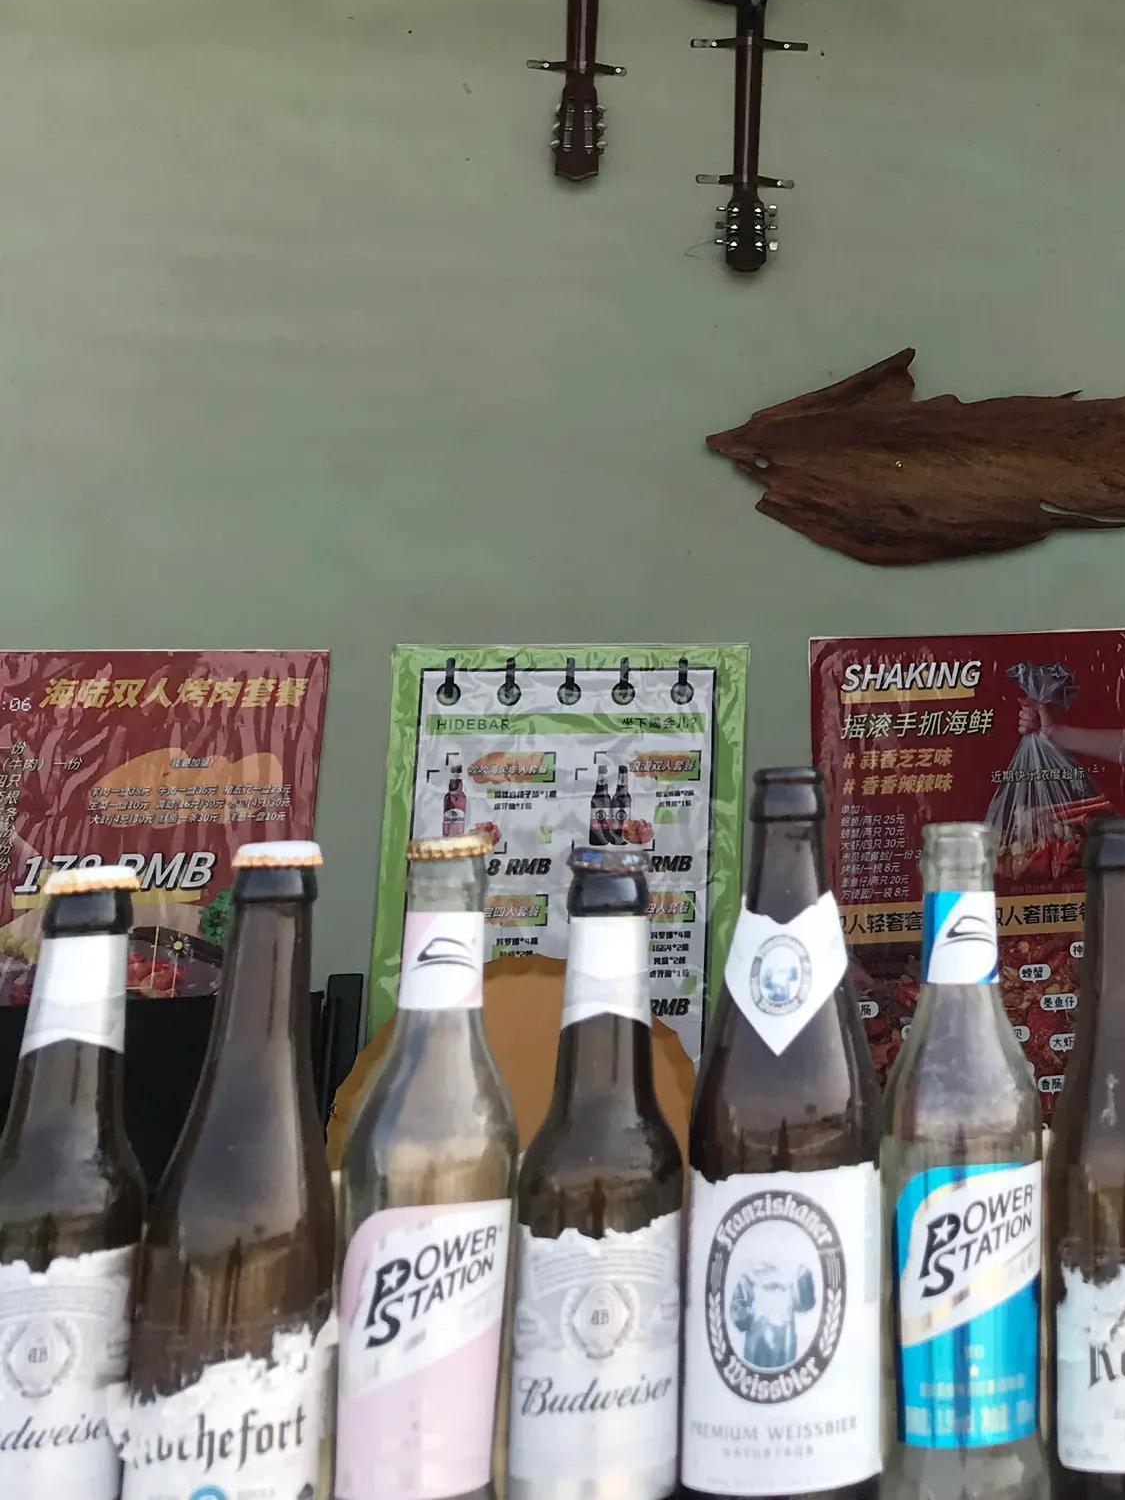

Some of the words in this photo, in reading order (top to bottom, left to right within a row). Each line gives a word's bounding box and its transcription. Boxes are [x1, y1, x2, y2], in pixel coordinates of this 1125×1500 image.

[39, 677, 310, 709] 海陆双人烤肉套餐
[840, 660, 982, 691] SHAKING
[436, 717, 510, 732] HIDEBAR
[840, 708, 994, 741] 摇滚手抓海鲜
[505, 857, 552, 876] RMB
[919, 1183, 1034, 1281] POWER
[920, 1209, 1034, 1300] STATION
[365, 1225, 502, 1331] POWER
[365, 1252, 496, 1349] STATION
[518, 1374, 673, 1417] Budweiser
[722, 1356, 822, 1402] Weissbier
[690, 1419, 760, 1442] PREMIUM
[768, 1414, 858, 1443] WEISSBIER
